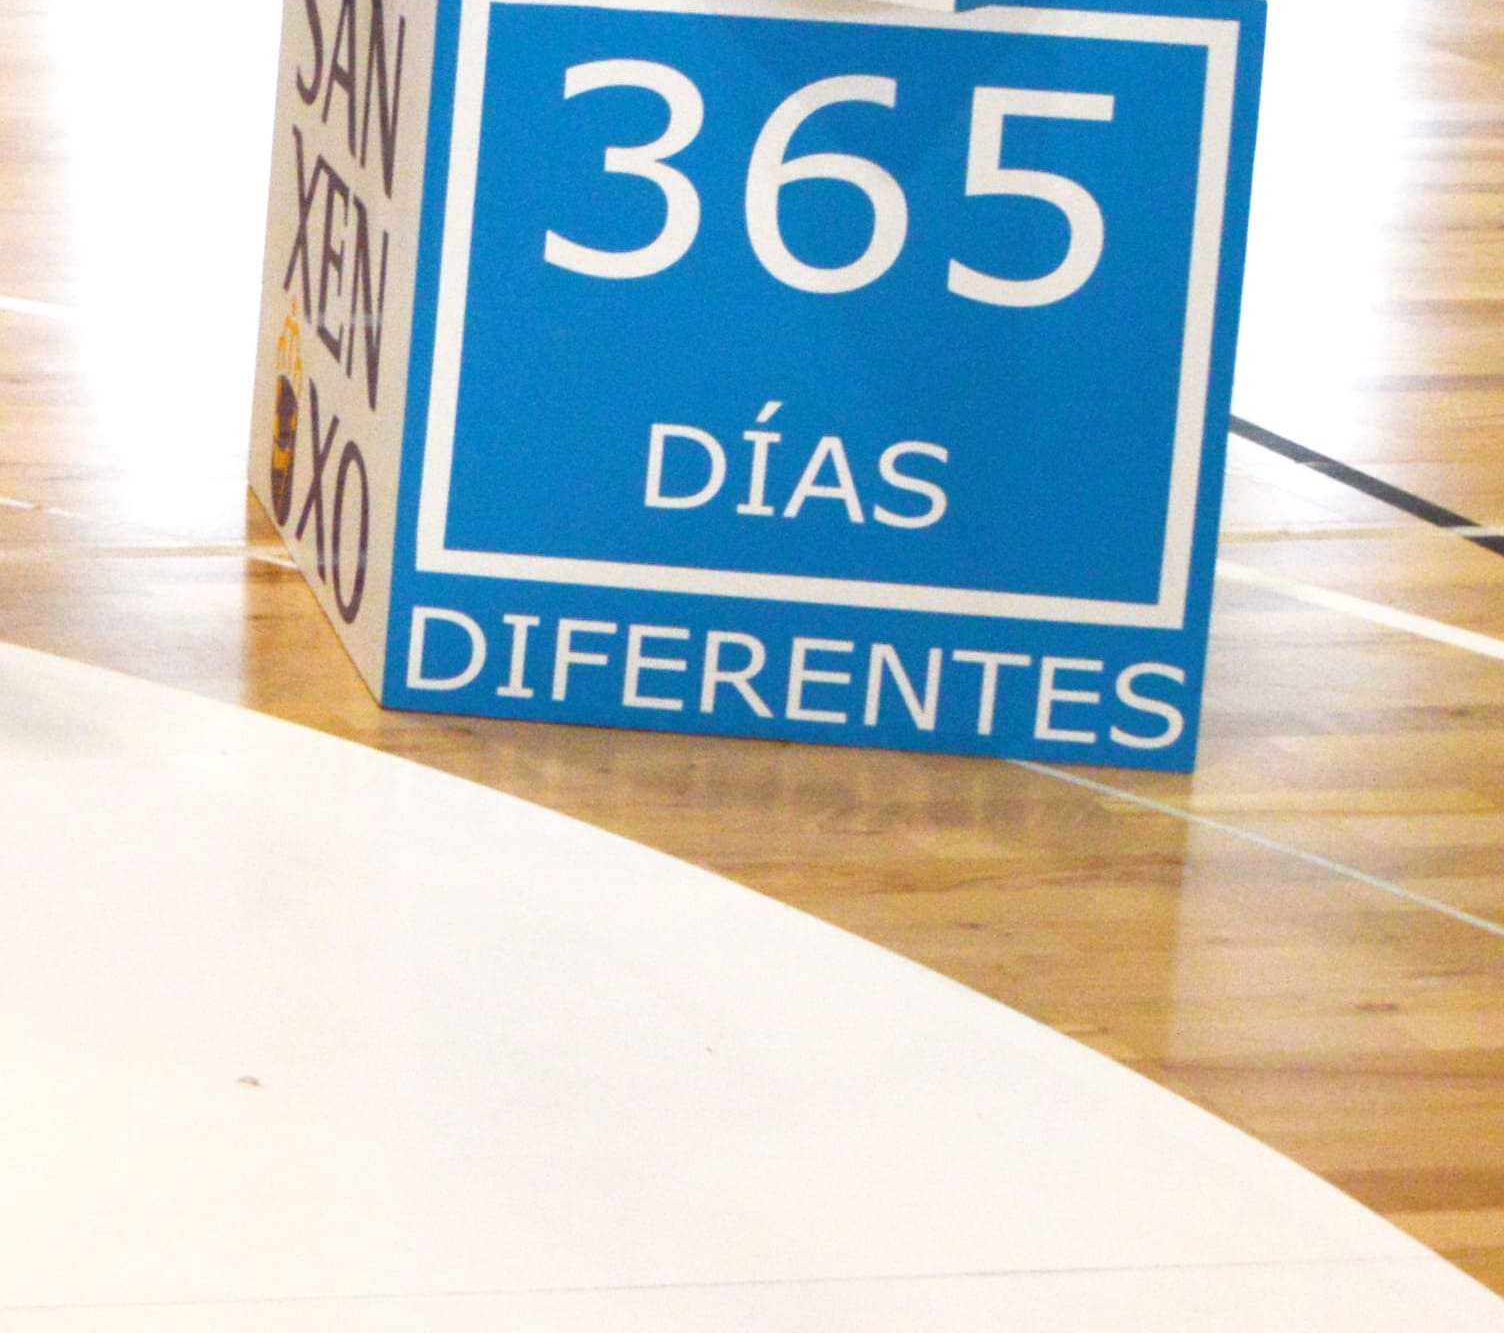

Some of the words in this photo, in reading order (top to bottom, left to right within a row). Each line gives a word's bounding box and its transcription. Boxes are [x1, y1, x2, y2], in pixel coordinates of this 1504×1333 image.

[283, 123, 392, 413] XEN
[542, 57, 1116, 309] 365
[294, 377, 371, 626] XO
[643, 401, 949, 530] DÍAS
[405, 604, 1186, 751] DIFERENTES
